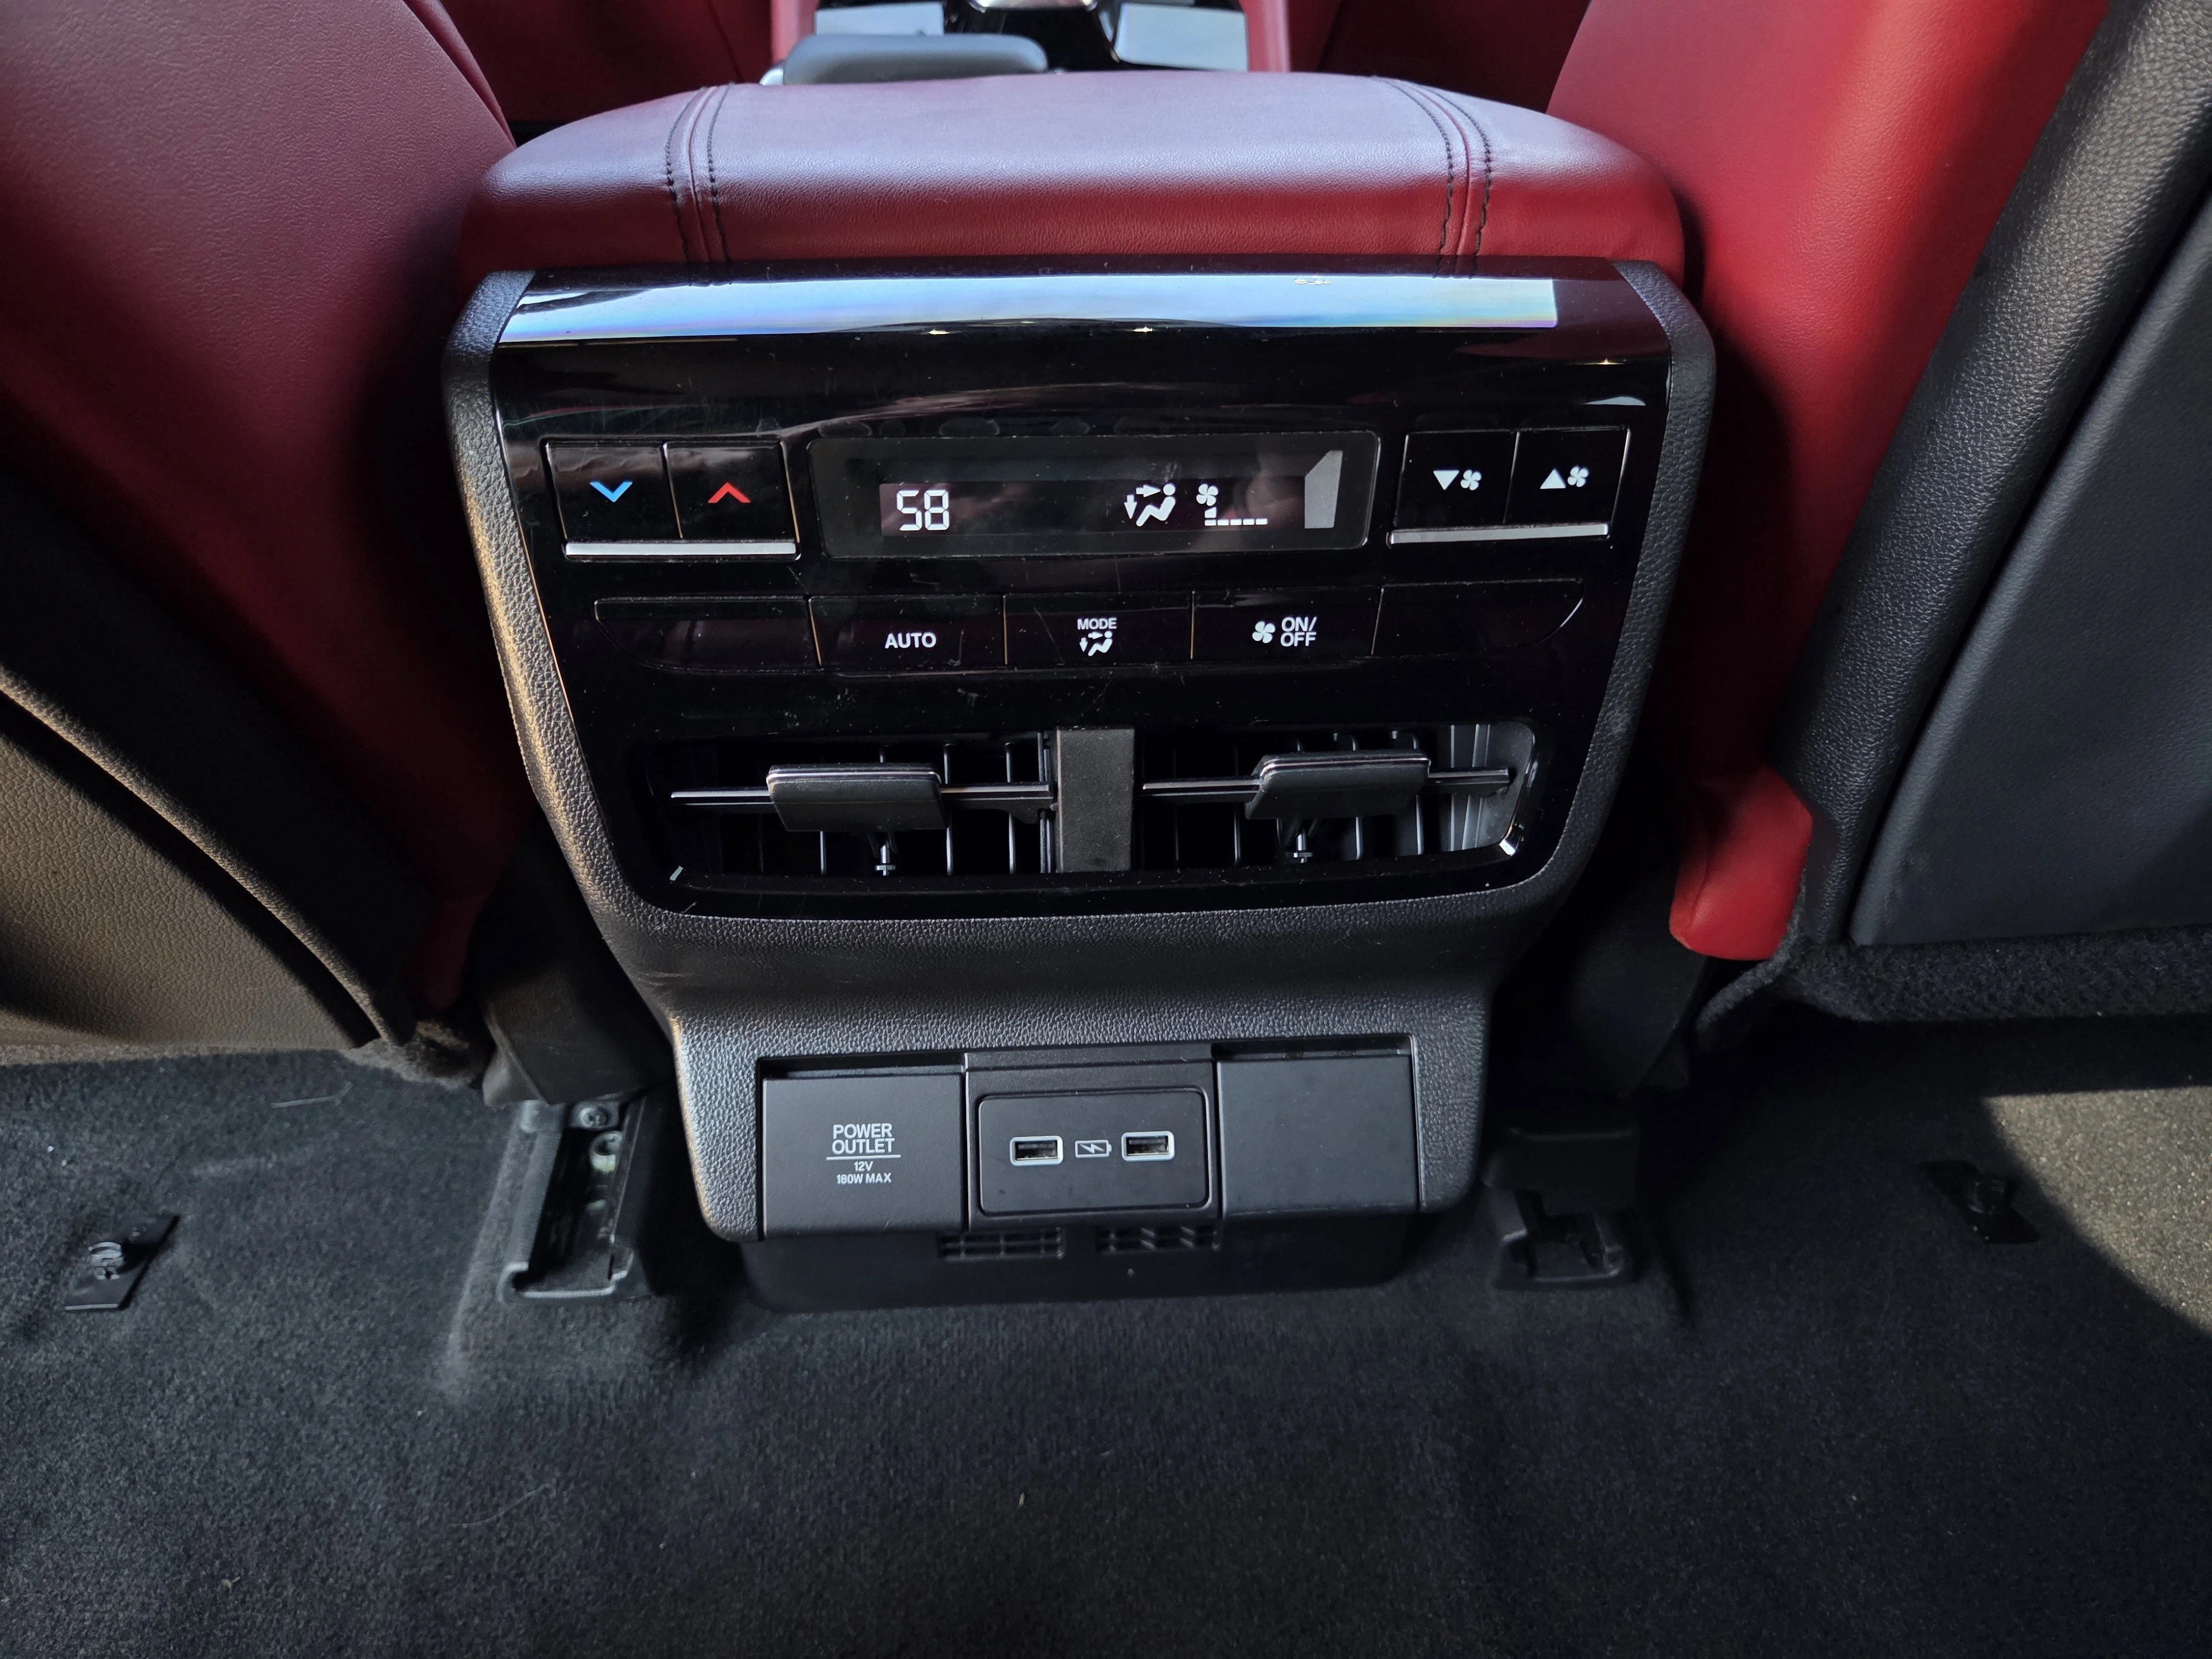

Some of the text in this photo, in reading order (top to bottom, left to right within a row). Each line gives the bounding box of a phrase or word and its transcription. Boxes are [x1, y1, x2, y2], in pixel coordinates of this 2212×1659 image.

[896, 490, 950, 531] 58
[1077, 617, 1117, 630] MODE
[1281, 617, 1317, 632] ON/
[885, 632, 937, 649] AUTO
[1280, 632, 1317, 647] OFF
[833, 1123, 893, 1139] POWER
[832, 1138, 895, 1155] OUTLET
[854, 1161, 874, 1172] 12V
[836, 1172, 892, 1185] 180W MAX
